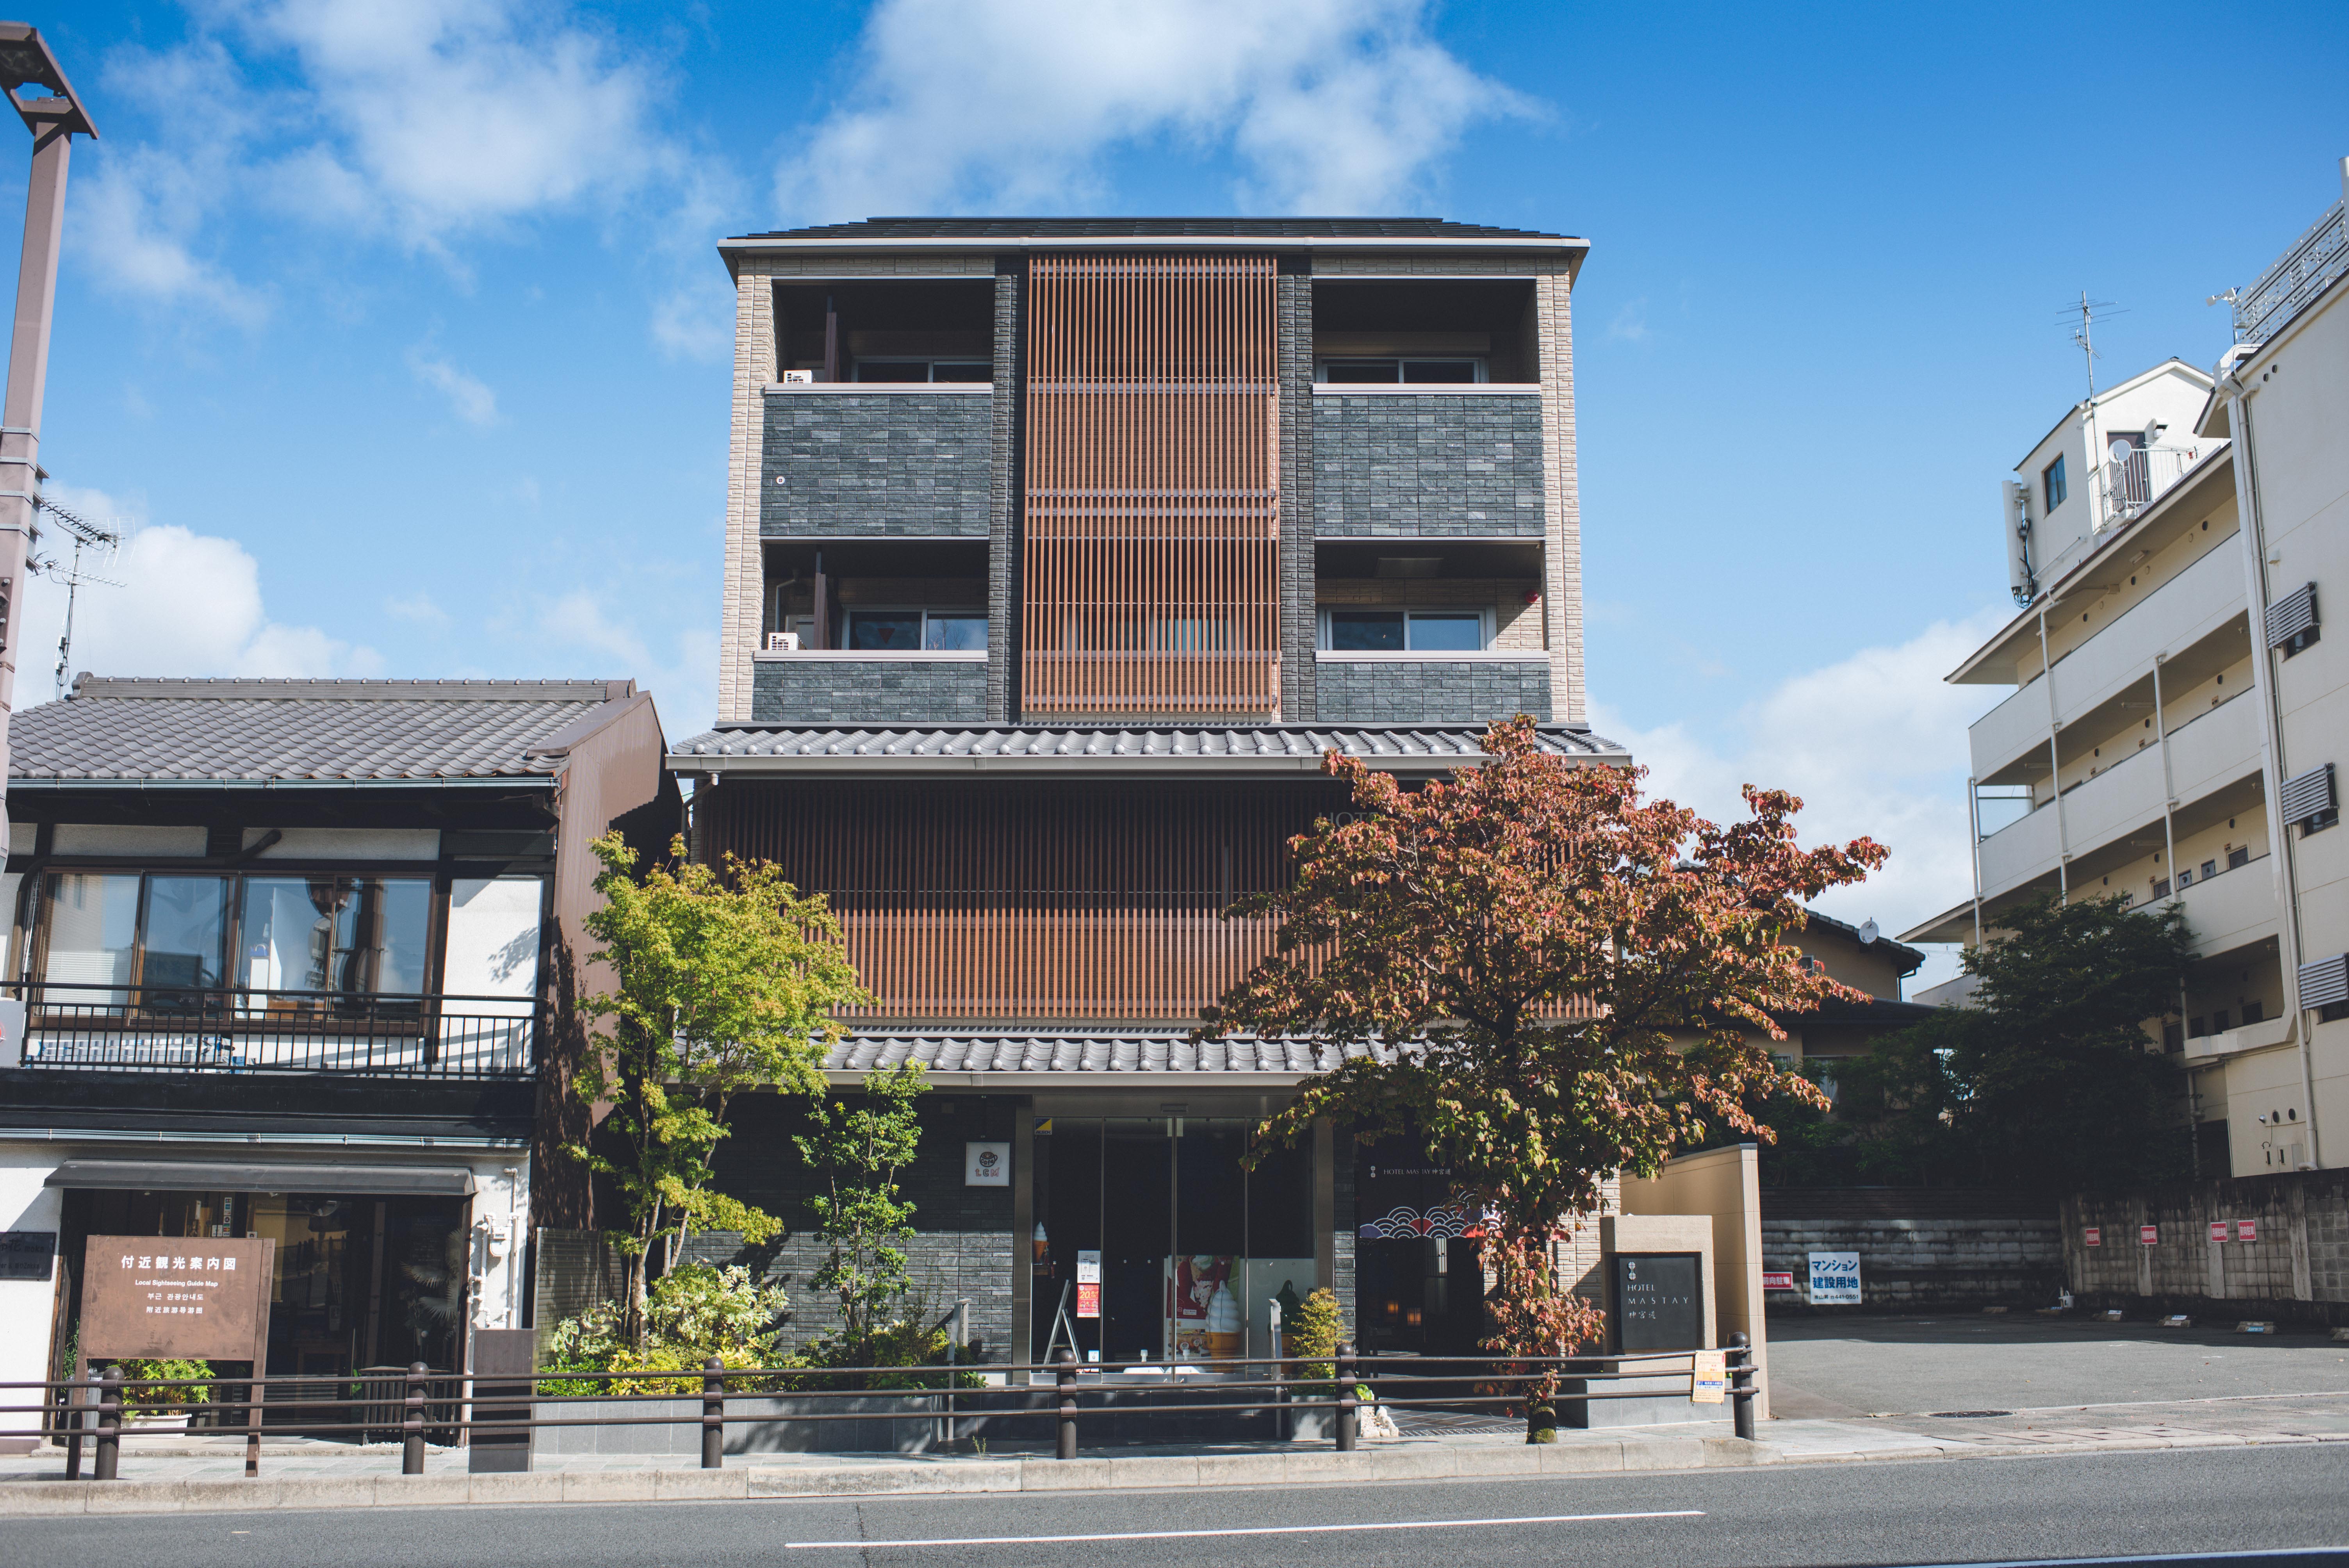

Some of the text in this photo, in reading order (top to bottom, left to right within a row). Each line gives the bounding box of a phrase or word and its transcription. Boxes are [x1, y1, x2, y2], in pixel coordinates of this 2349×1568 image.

[975, 1167, 1000, 1178] LCM
[2239, 1226, 2255, 1236] 前向駐車
[121, 1255, 236, 1270] 付近観光案内図
[1812, 1260, 1857, 1272] マンション
[1763, 1276, 1791, 1285] 前向駐車
[1813, 1277, 1859, 1289] 建設用地
[1628, 1297, 1688, 1305] MASTAY
[146, 1306, 203, 1314] 附近旅游导游图
[1628, 1310, 1656, 1319] 神宮道
